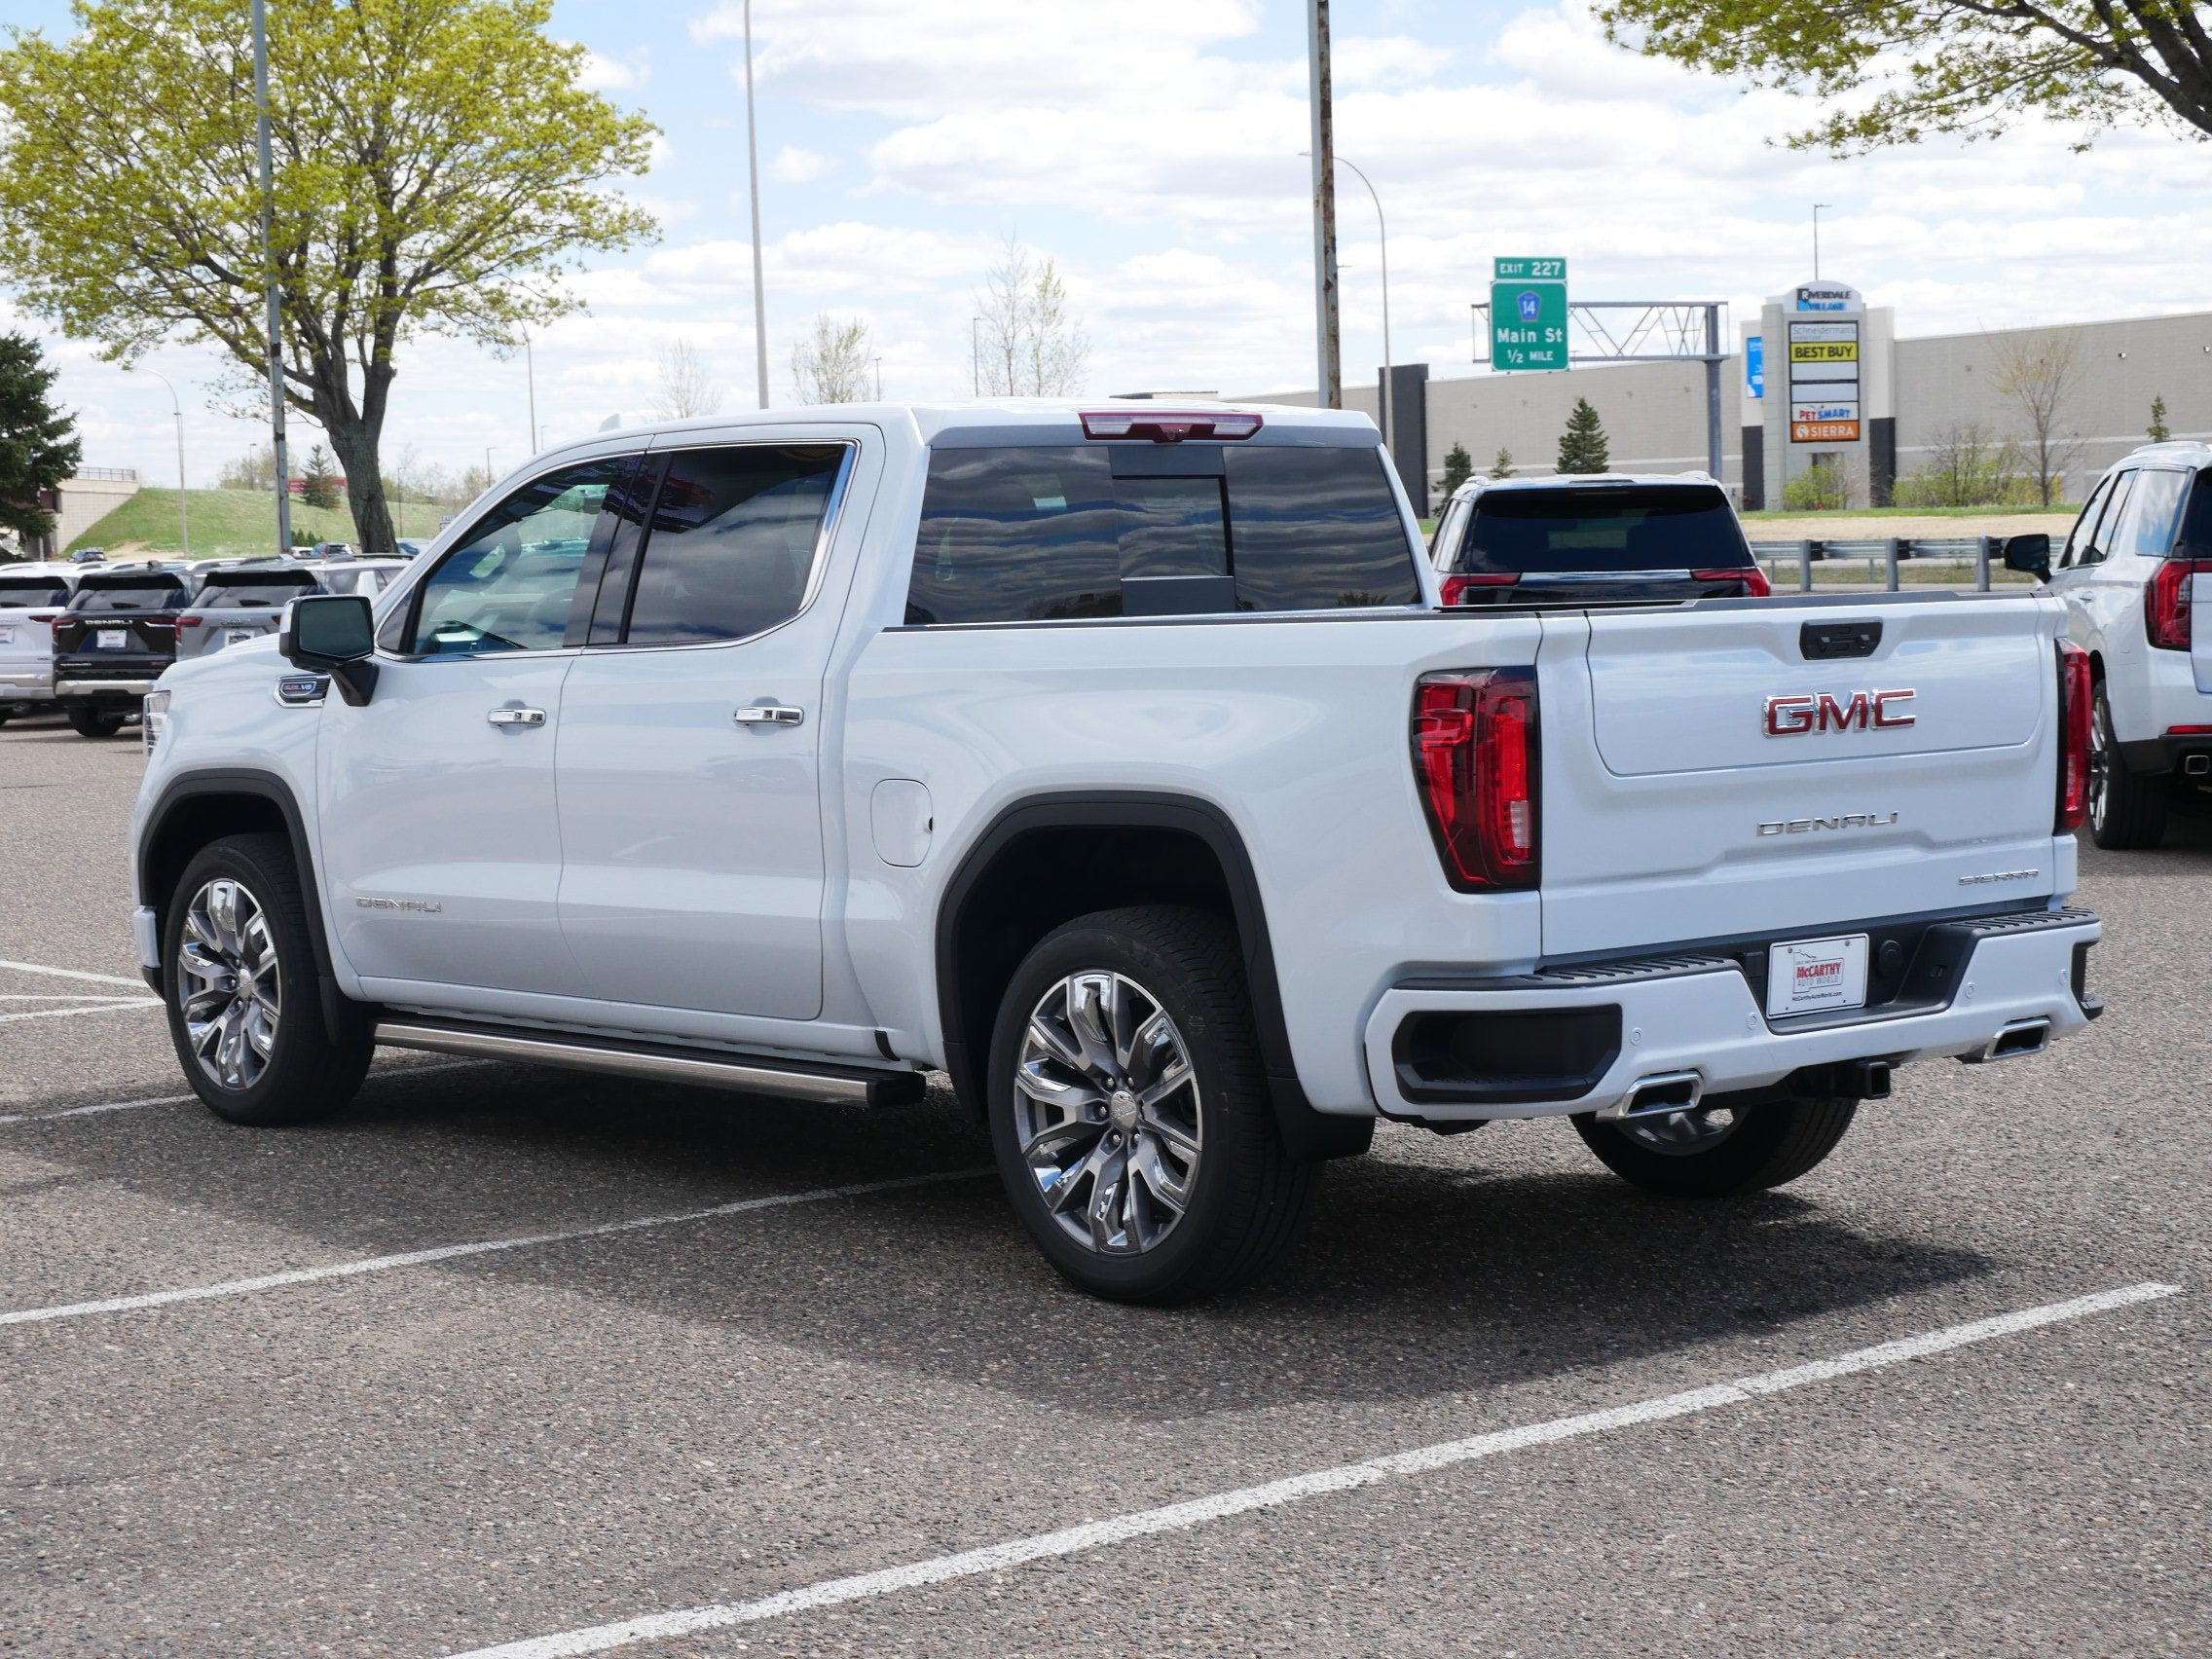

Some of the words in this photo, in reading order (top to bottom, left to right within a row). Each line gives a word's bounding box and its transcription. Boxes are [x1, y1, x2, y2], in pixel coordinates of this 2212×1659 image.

[1499, 263, 1524, 274] EXIT
[1531, 262, 1562, 276] 227
[1523, 300, 1535, 314] 14
[1496, 328, 1536, 343] Main
[1545, 327, 1563, 343] St
[1530, 350, 1554, 361] MILE
[1794, 347, 1825, 358] BEST
[1827, 346, 1853, 357] BUY
[1811, 425, 1855, 437] SIERRA
[1761, 687, 1916, 739] GMC
[1756, 810, 1899, 837] DENALI
[1958, 868, 2039, 886] SIERRA
[354, 895, 442, 913] DENALI
[1796, 962, 1842, 979] McCARTHY
[1797, 977, 1814, 986] AUTO
[1816, 975, 1839, 985] WORLD
